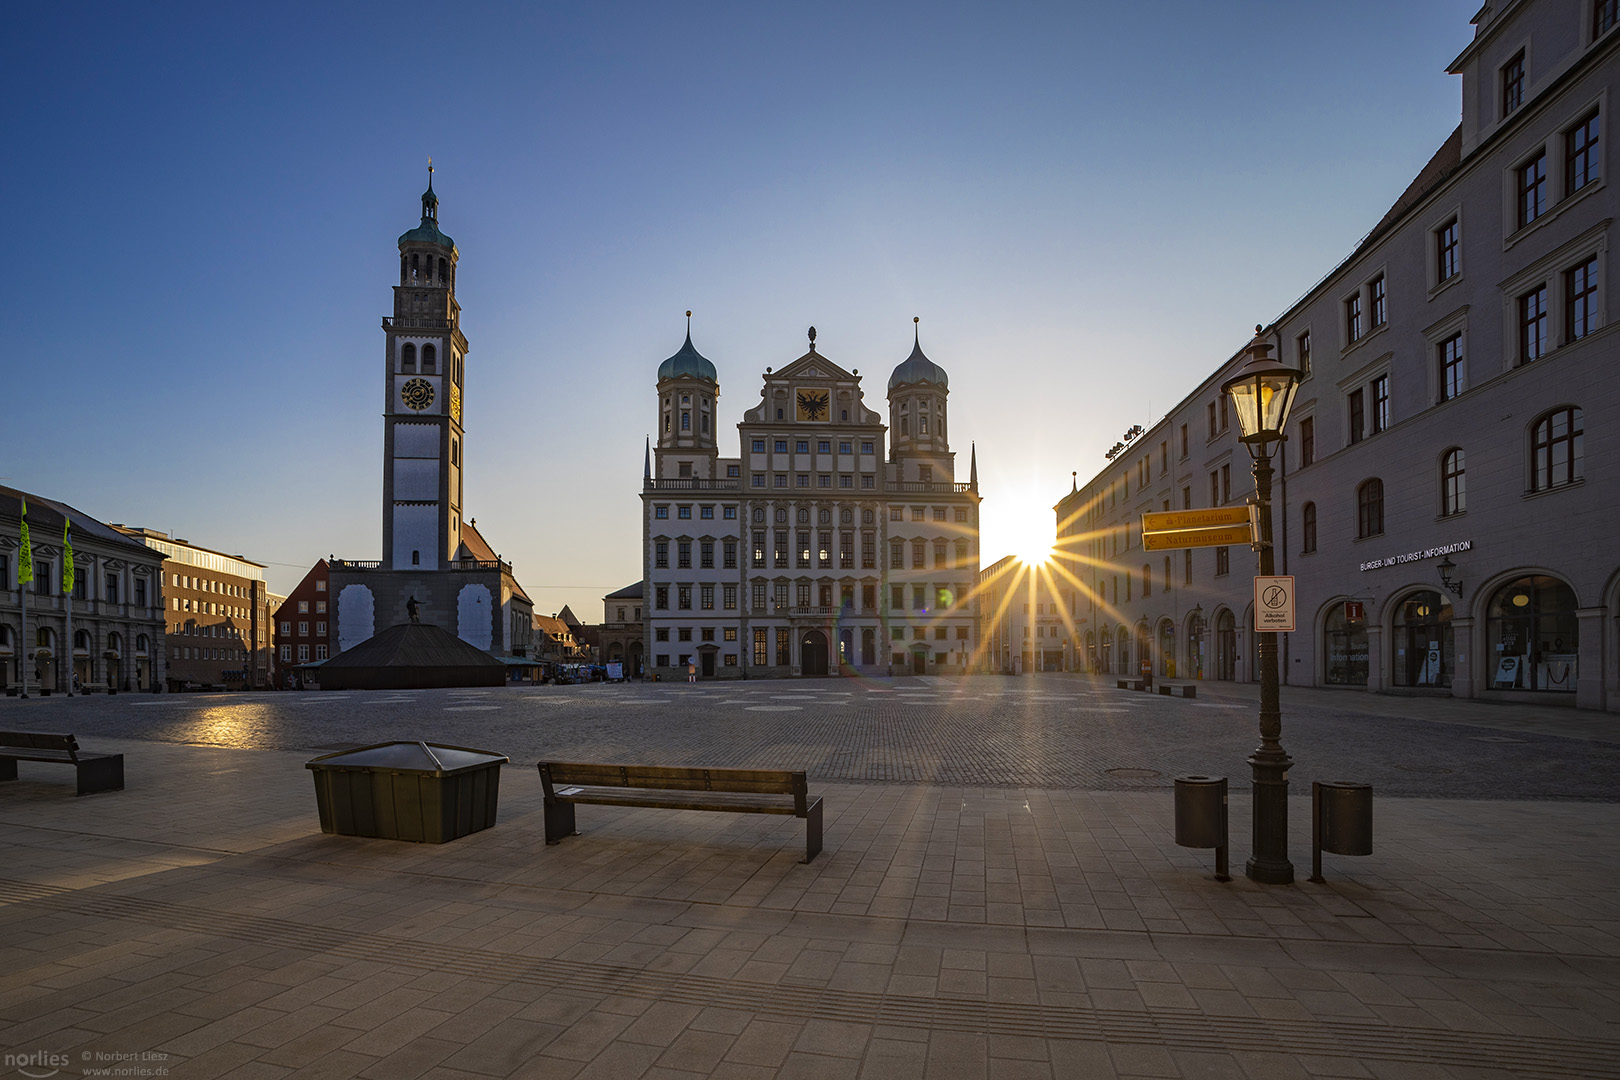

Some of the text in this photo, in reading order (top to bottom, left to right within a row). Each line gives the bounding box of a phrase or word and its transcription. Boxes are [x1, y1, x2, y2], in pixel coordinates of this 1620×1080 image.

[1166, 534, 1232, 545] Naturmuseum
[1384, 557, 1396, 567] UND
[1396, 541, 1471, 563] TOURIST-INFORMATION
